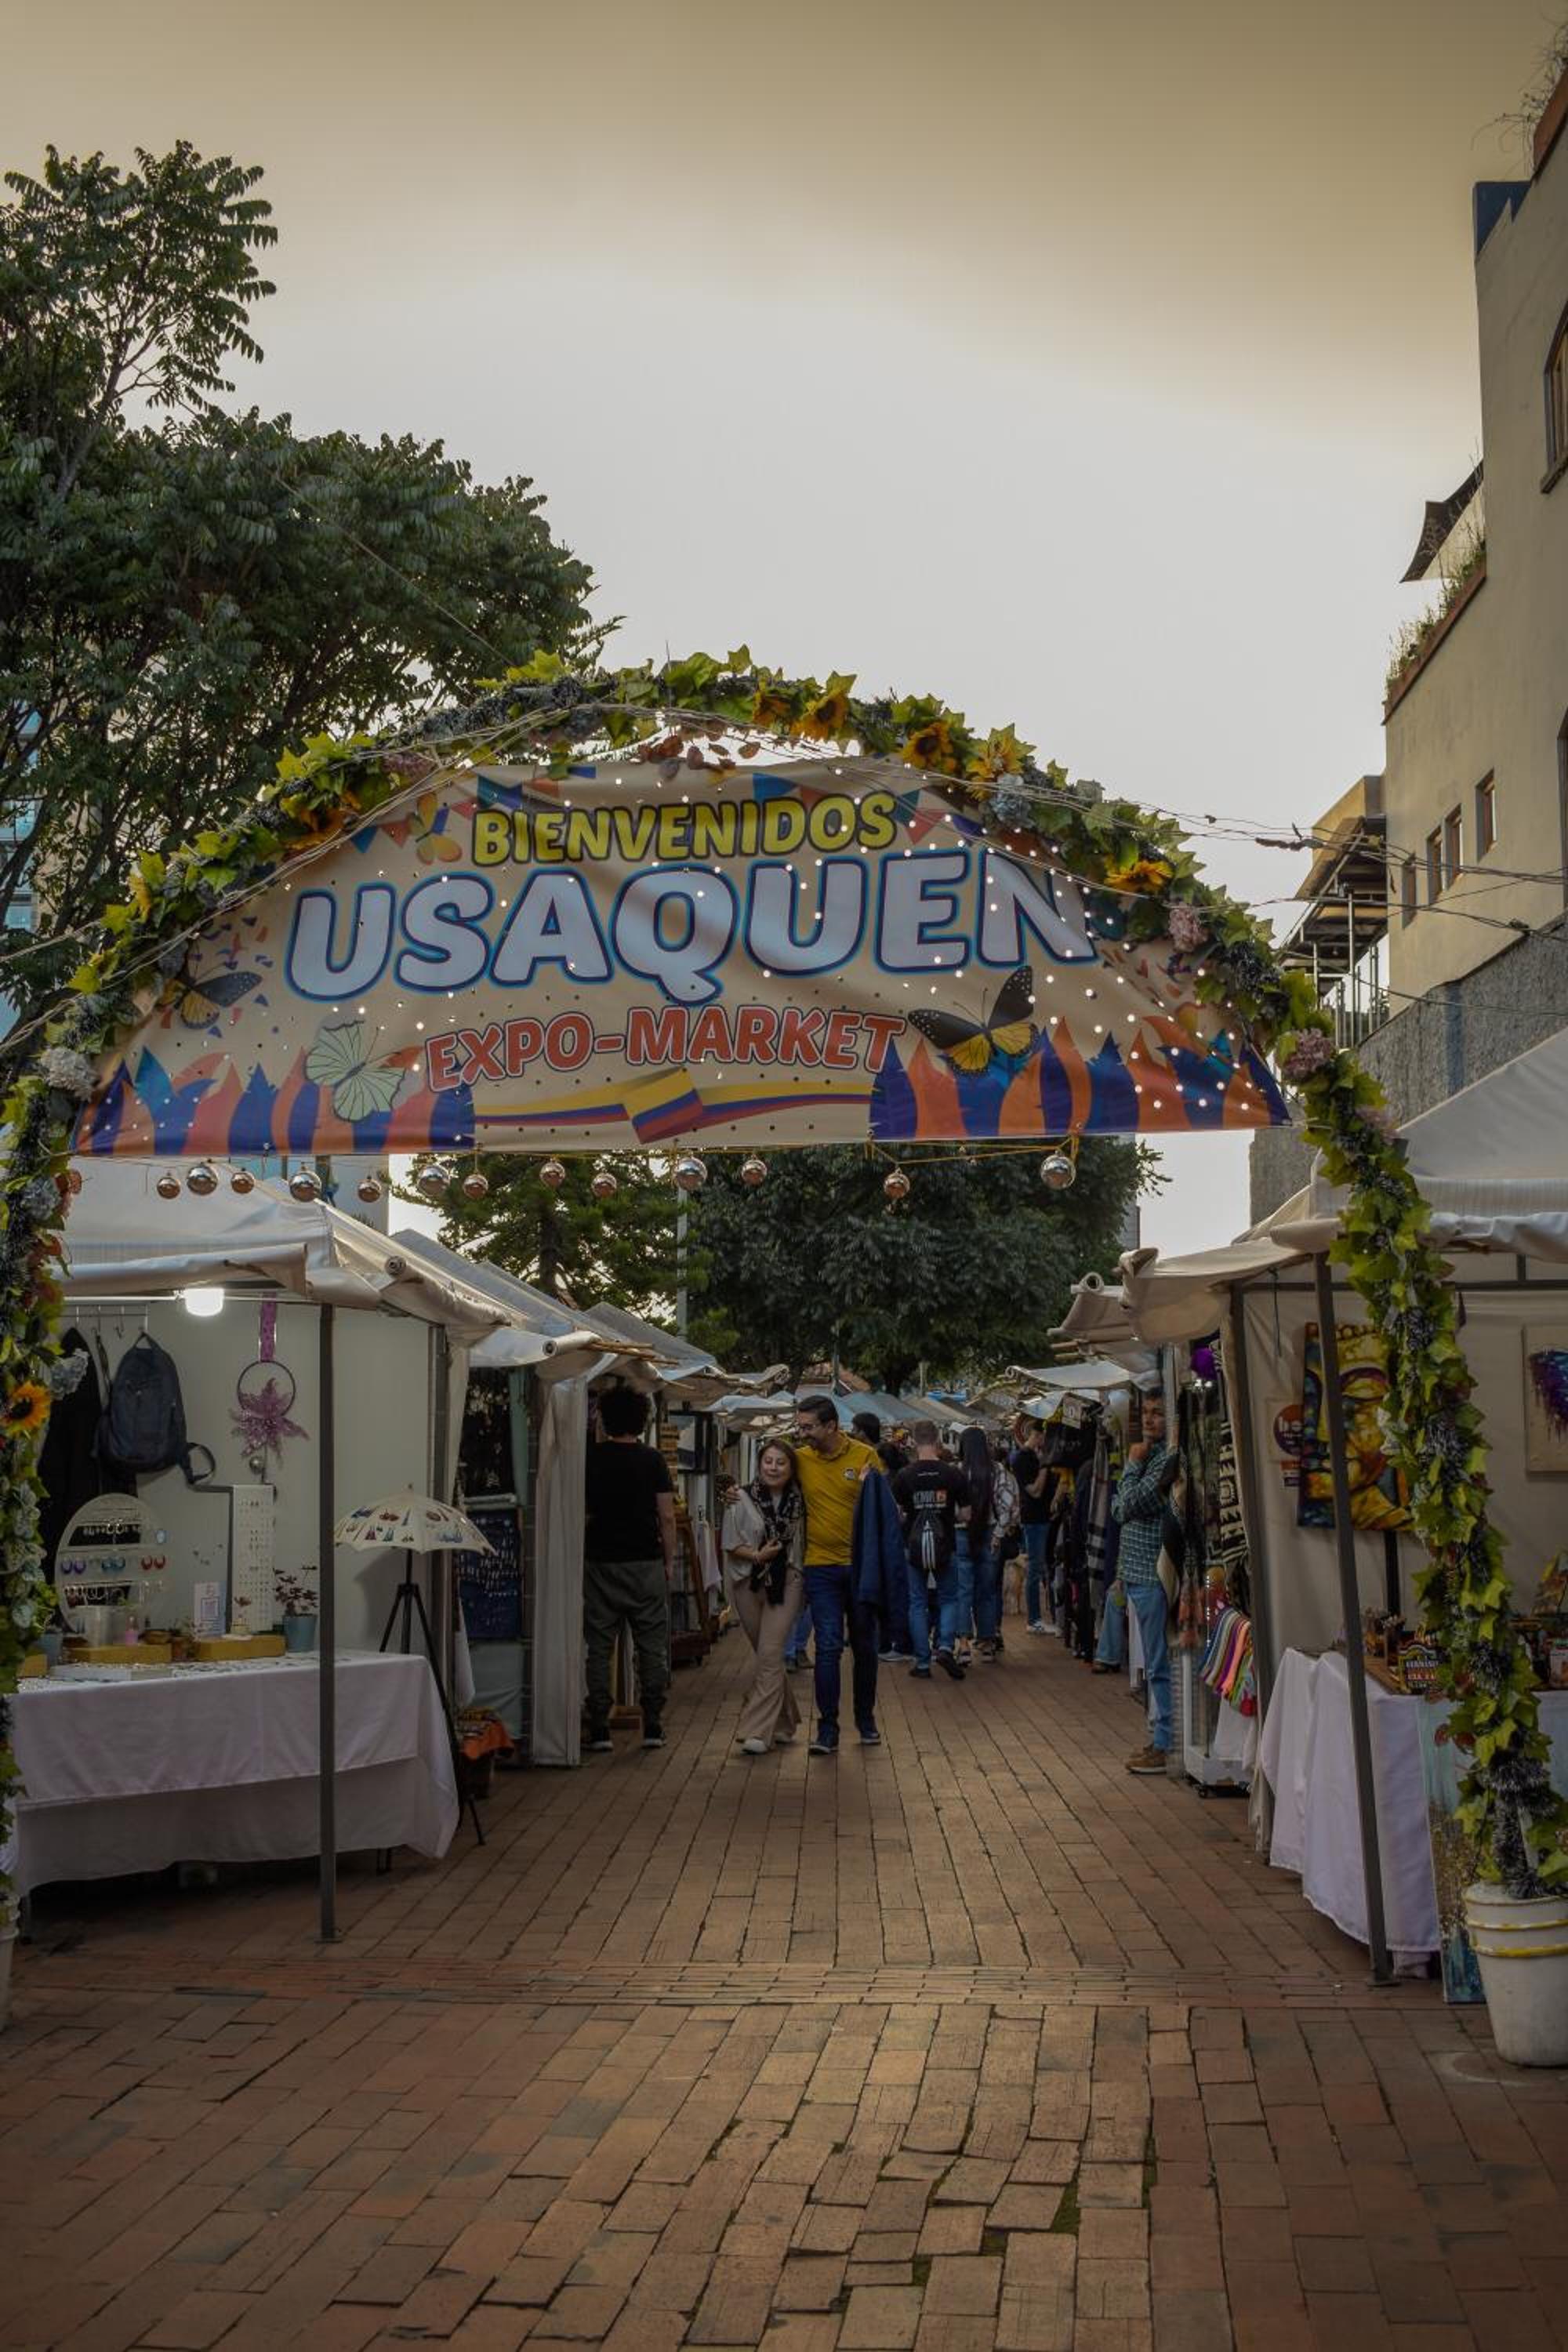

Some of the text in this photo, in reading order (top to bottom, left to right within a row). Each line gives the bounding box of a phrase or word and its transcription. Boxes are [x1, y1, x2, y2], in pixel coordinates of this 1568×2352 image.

[471, 790, 898, 866] BIENVENIDOS
[285, 847, 1098, 1006] USAQUEN
[426, 1005, 907, 1092] EXPO-MARKET
